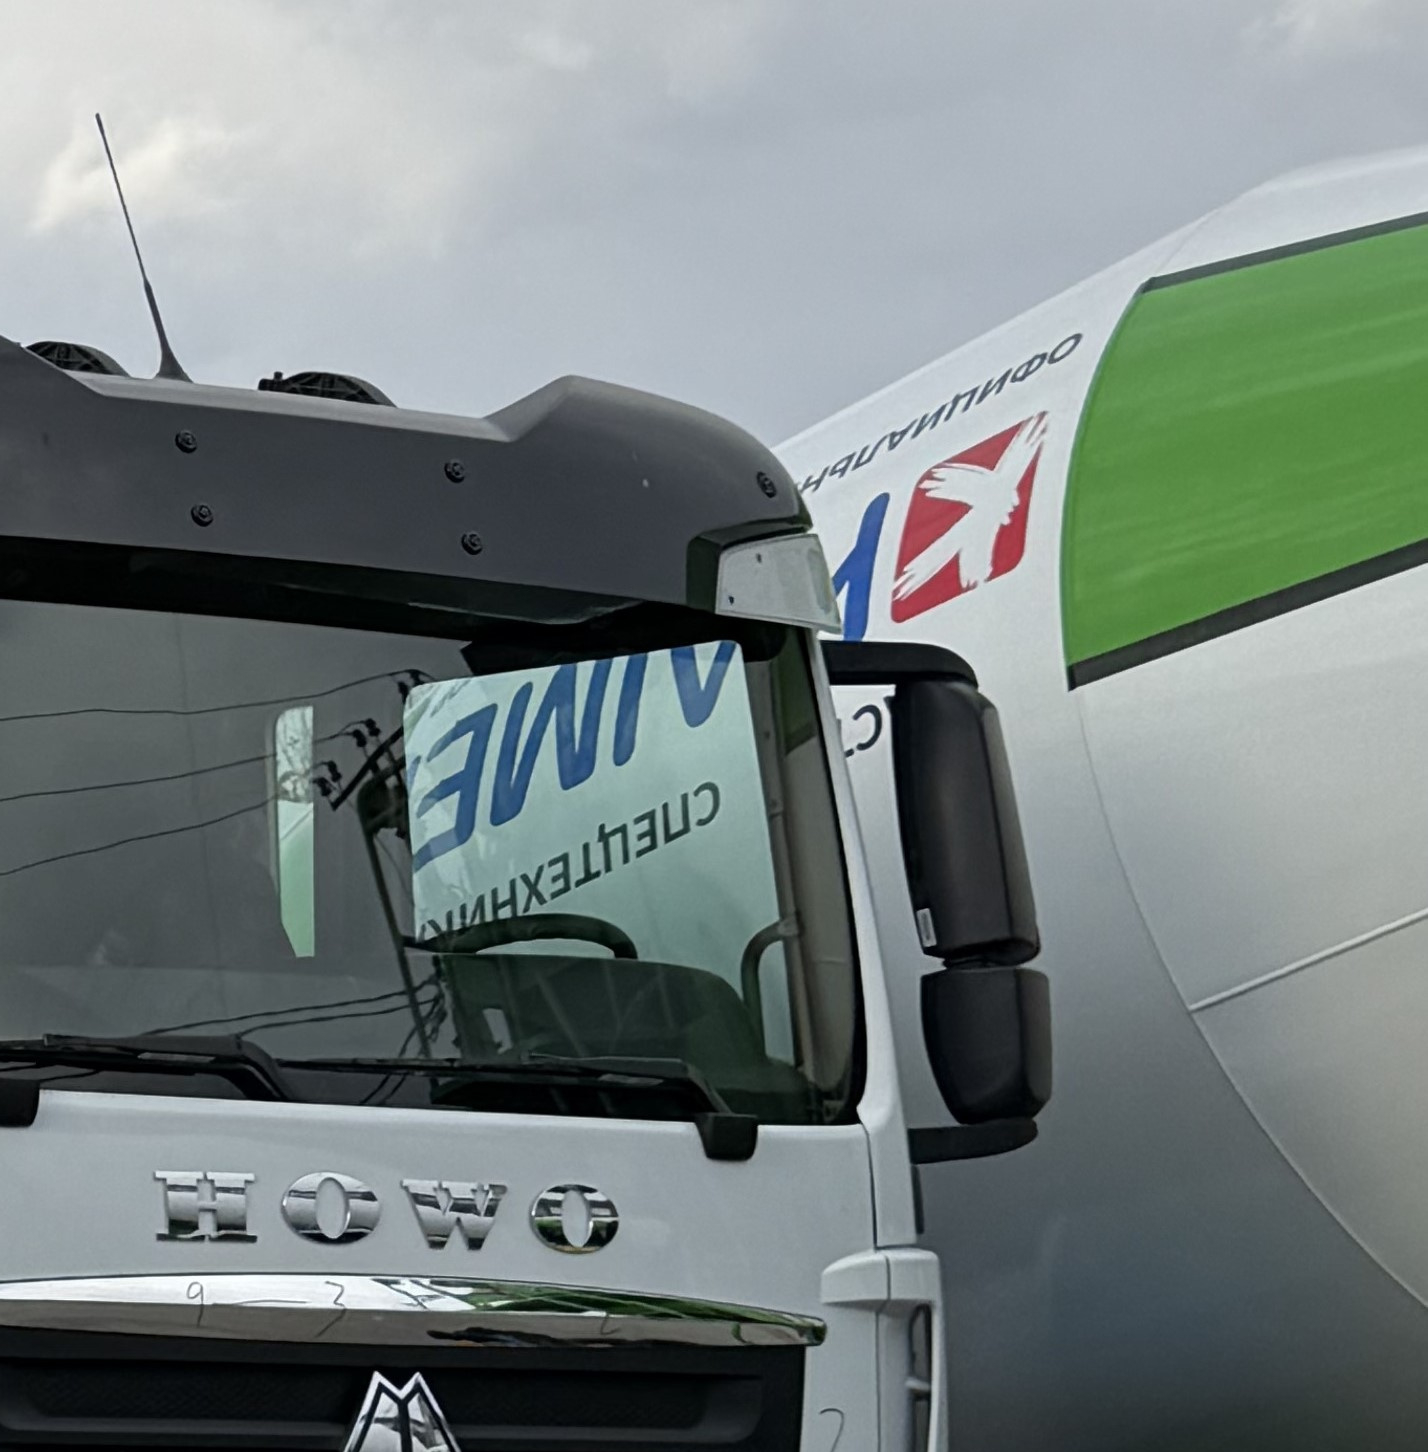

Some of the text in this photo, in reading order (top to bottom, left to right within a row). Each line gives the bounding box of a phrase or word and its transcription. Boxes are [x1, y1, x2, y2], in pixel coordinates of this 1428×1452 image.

[799, 332, 1084, 494] ОФИЦИАЛЬН
[417, 781, 722, 943] СПЕЦТЕХНИ
[153, 1169, 621, 1256] HOWO
